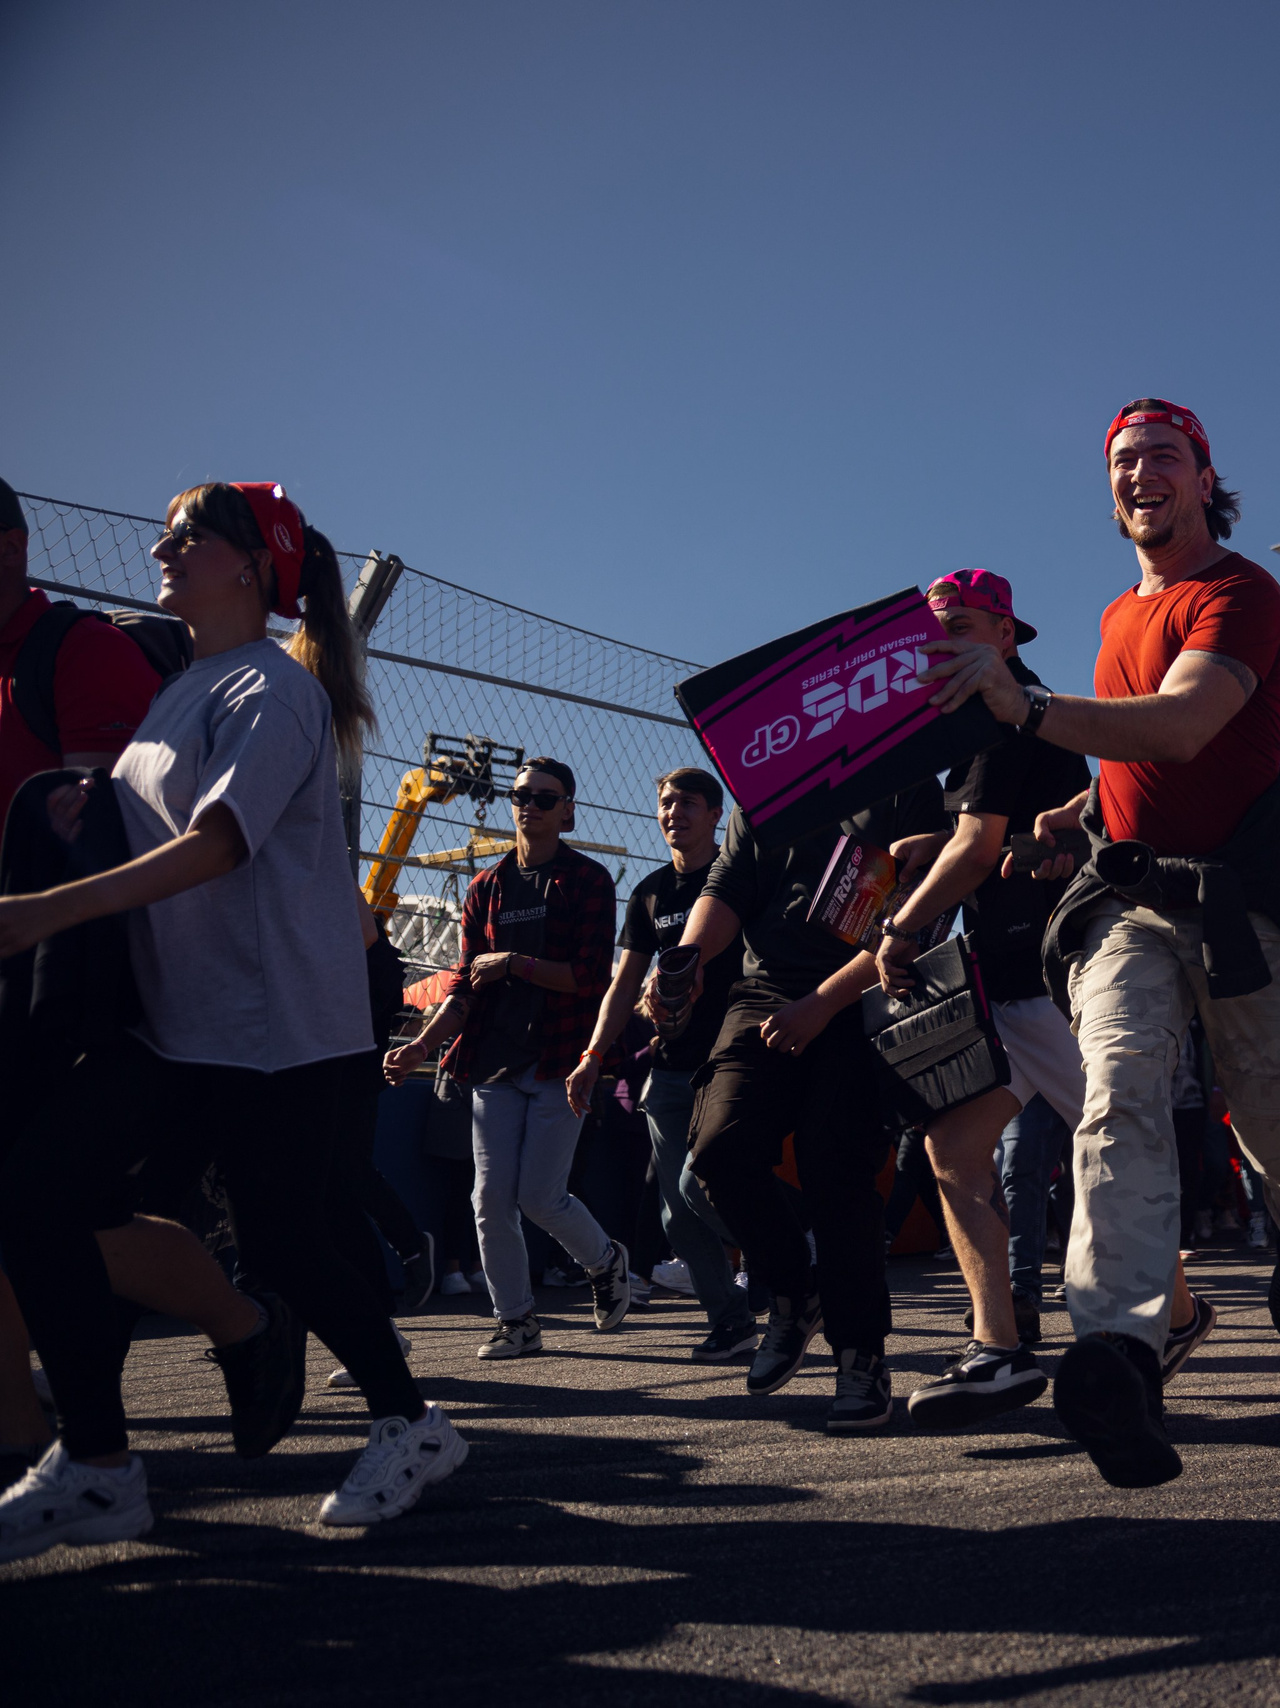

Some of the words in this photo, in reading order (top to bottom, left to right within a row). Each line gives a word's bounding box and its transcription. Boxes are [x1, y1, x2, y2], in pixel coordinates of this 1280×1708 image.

[844, 649, 876, 671] DRIFT
[879, 632, 927, 654] RUSSIAN
[802, 665, 840, 690] SERIES
[803, 646, 935, 741] RDS
[741, 715, 800, 768] GP
[833, 861, 859, 904] RDS
[851, 846, 863, 866] GP
